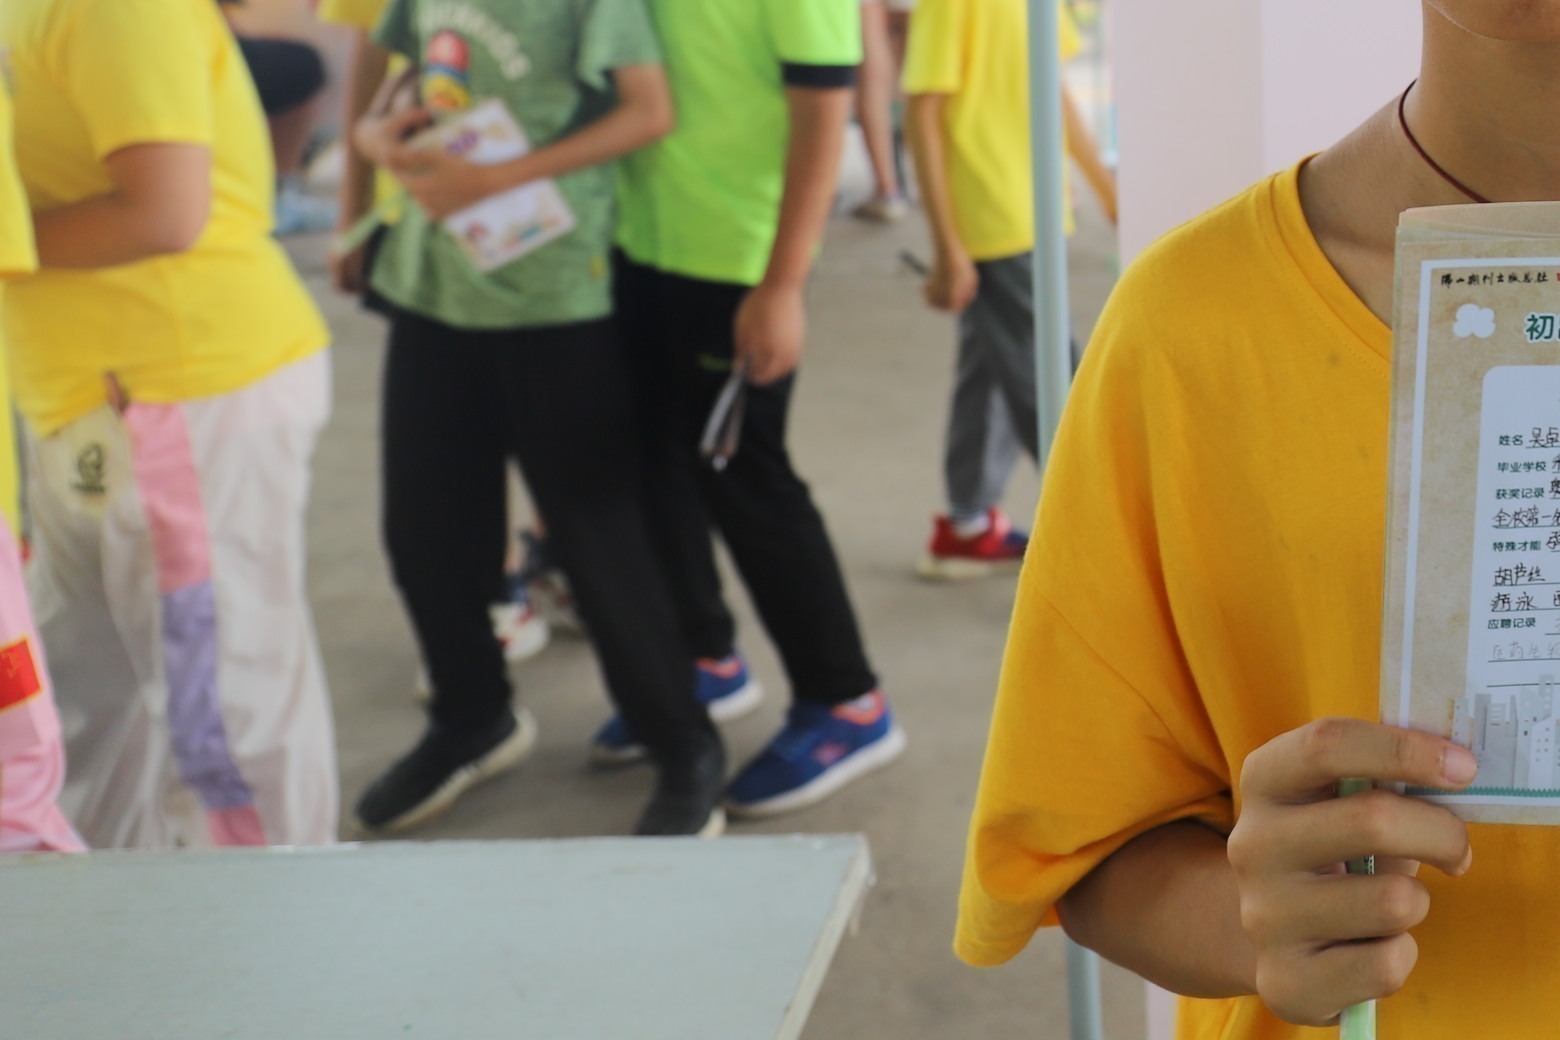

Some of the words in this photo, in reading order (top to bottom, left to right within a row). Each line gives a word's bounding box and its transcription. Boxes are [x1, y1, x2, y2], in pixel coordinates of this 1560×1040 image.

[1498, 434, 1524, 447] 姓名
[1497, 460, 1547, 473] 毕业学校
[1495, 487, 1545, 500] 获奖记录
[1492, 541, 1542, 552] 特殊才能
[1487, 617, 1537, 630] 应聘记录
